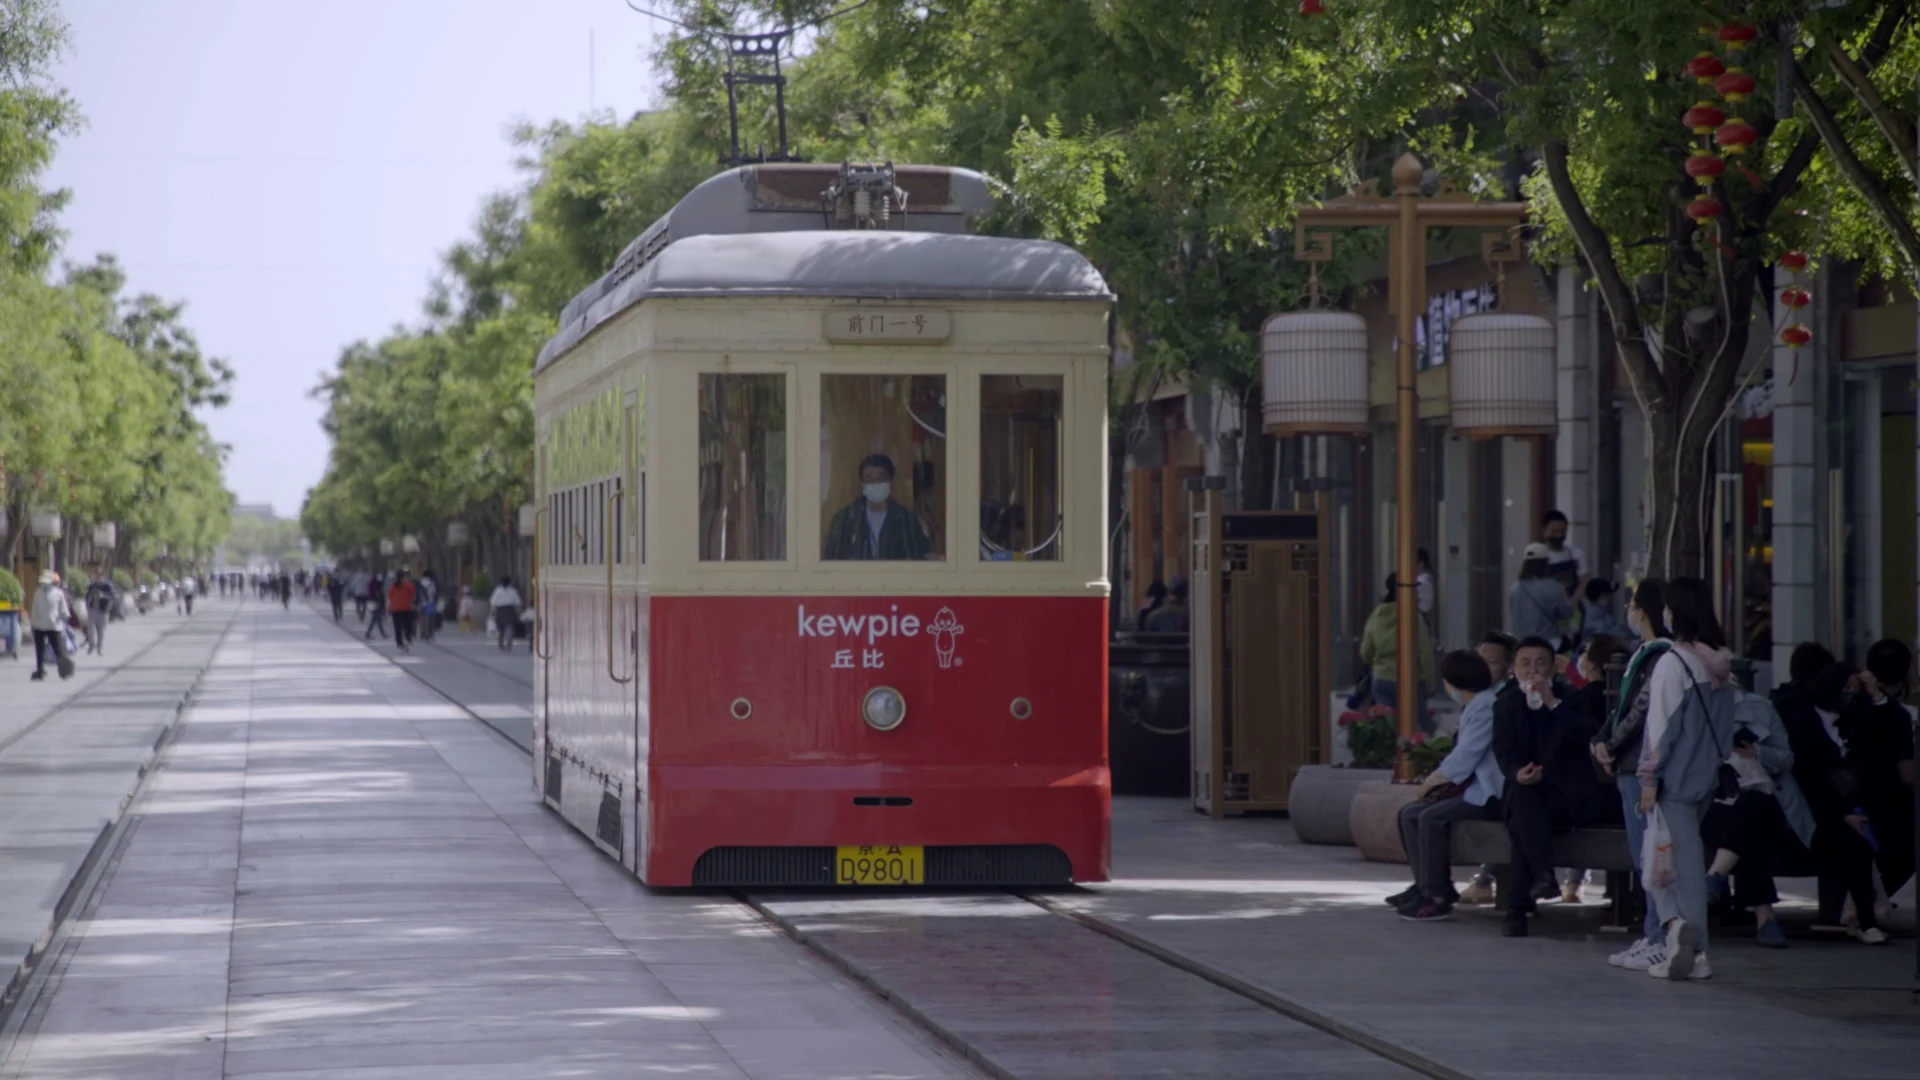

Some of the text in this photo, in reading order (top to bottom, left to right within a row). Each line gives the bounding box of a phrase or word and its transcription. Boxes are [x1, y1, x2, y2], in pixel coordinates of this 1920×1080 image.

[848, 314, 927, 334] 前门一号
[798, 604, 920, 645] kewpie
[831, 649, 884, 668] 丘比
[841, 857, 914, 881] D9801
